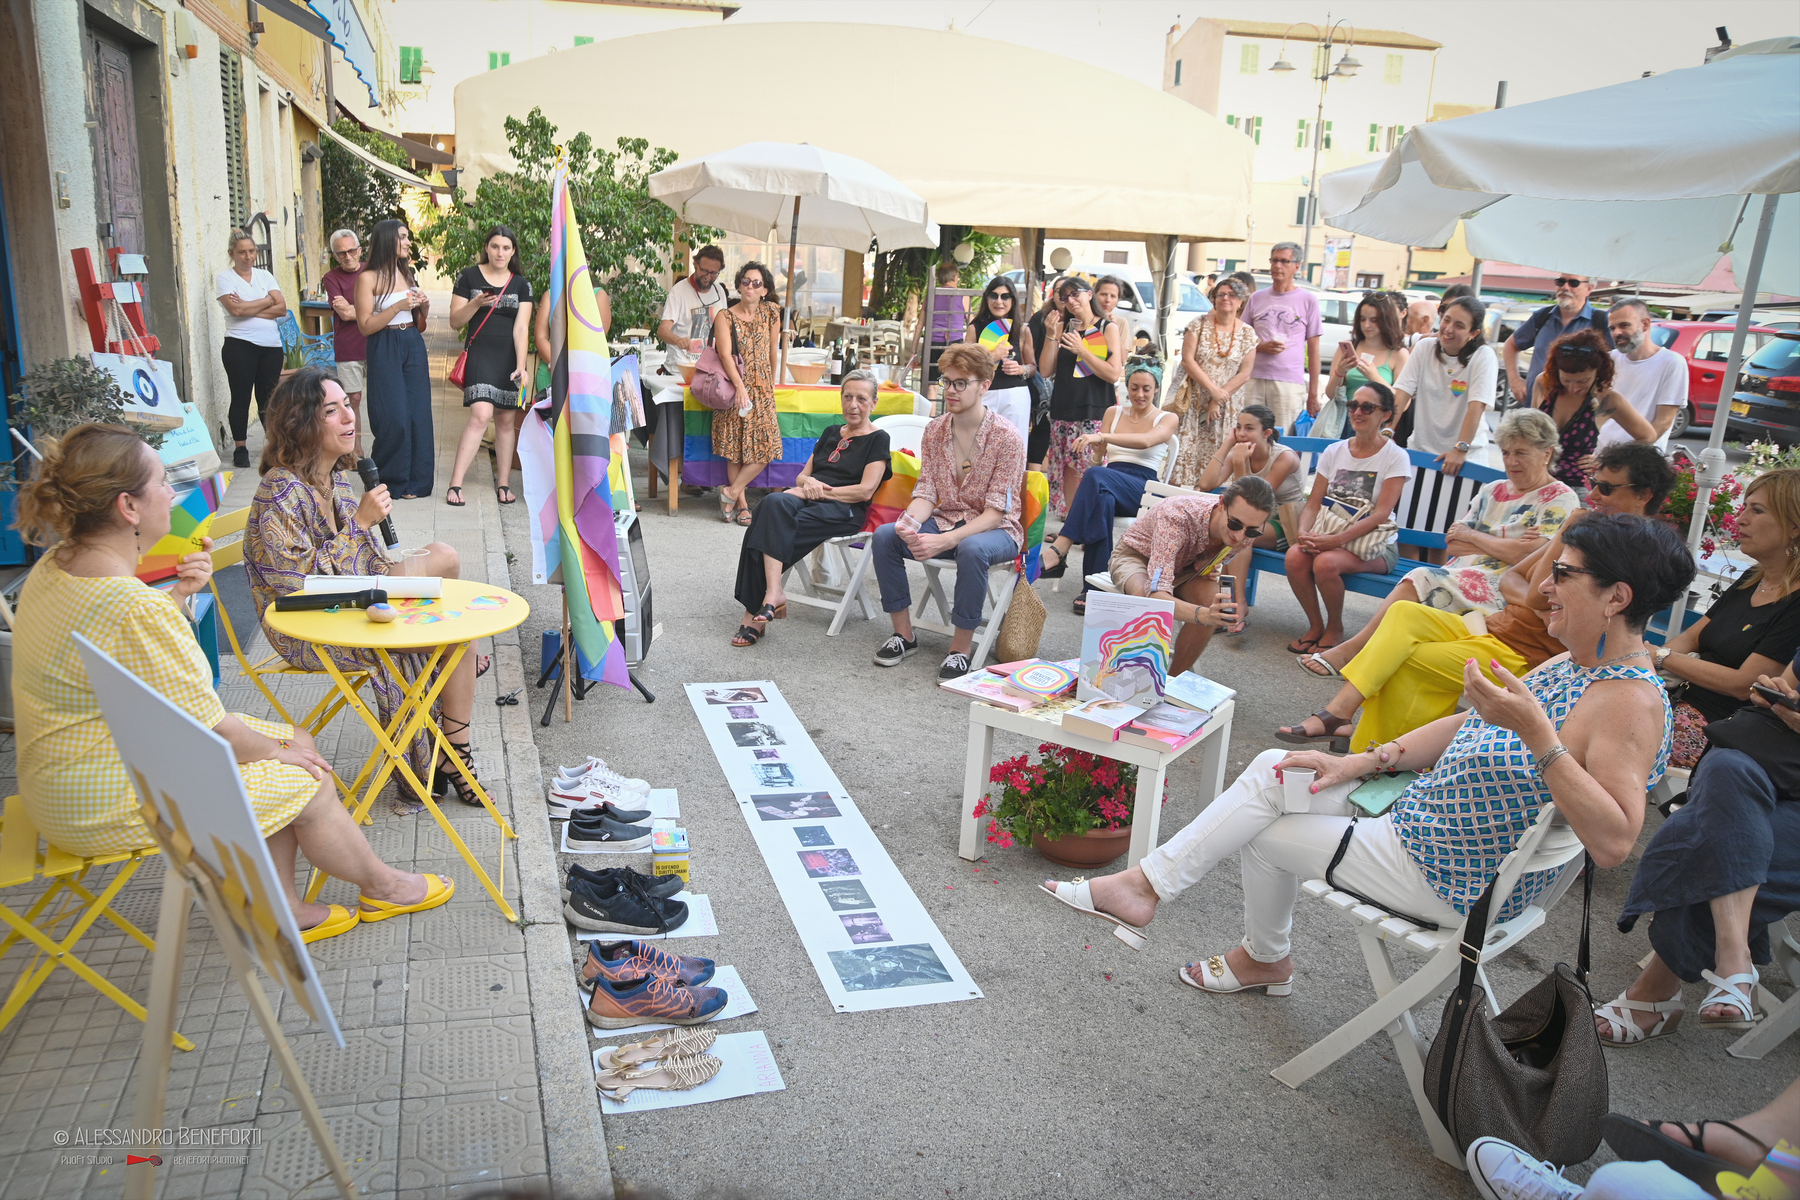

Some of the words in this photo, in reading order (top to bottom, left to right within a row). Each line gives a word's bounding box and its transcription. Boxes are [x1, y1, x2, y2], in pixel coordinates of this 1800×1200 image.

[583, 901, 604, 917] SCARPA
[723, 977, 755, 1012] PIETRO
[748, 1043, 781, 1087] ARIANNA
